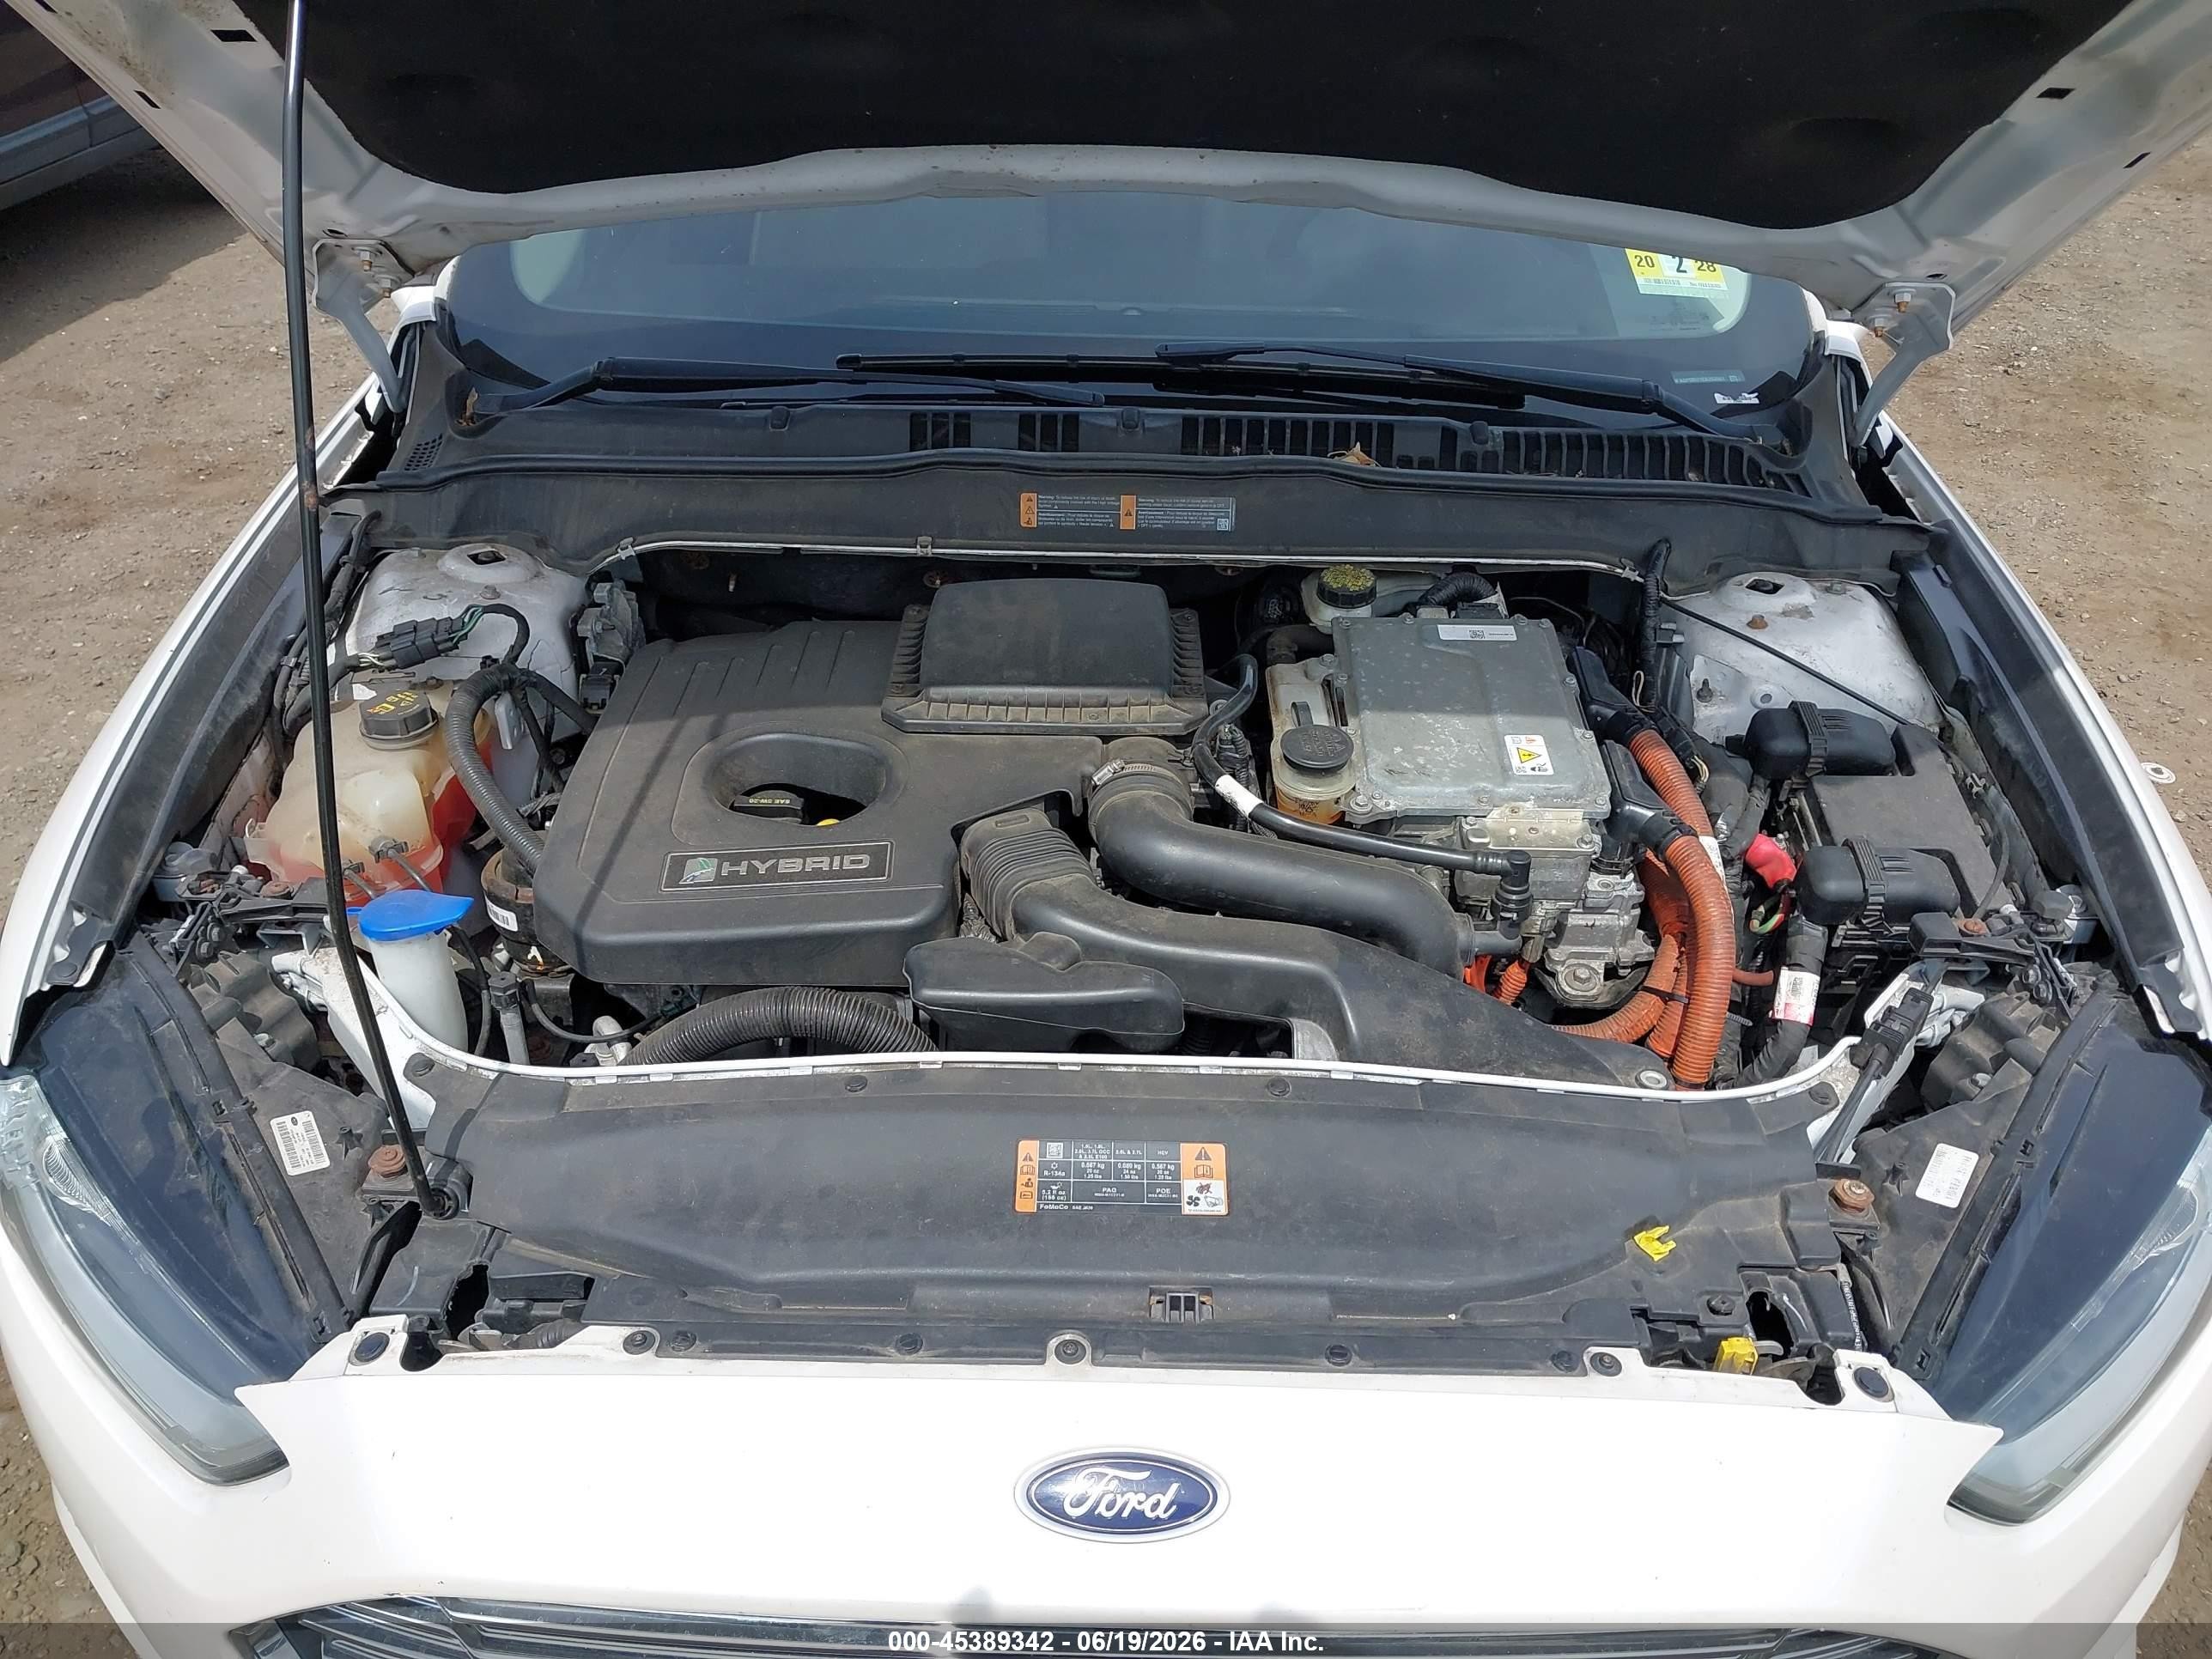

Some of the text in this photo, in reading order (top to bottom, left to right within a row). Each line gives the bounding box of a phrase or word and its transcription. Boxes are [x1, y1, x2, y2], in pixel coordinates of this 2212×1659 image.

[1634, 254, 1656, 268] 20
[1694, 260, 1717, 273] 28
[720, 854, 871, 876] HYBRID
[1063, 1466, 1182, 1519] Ford
